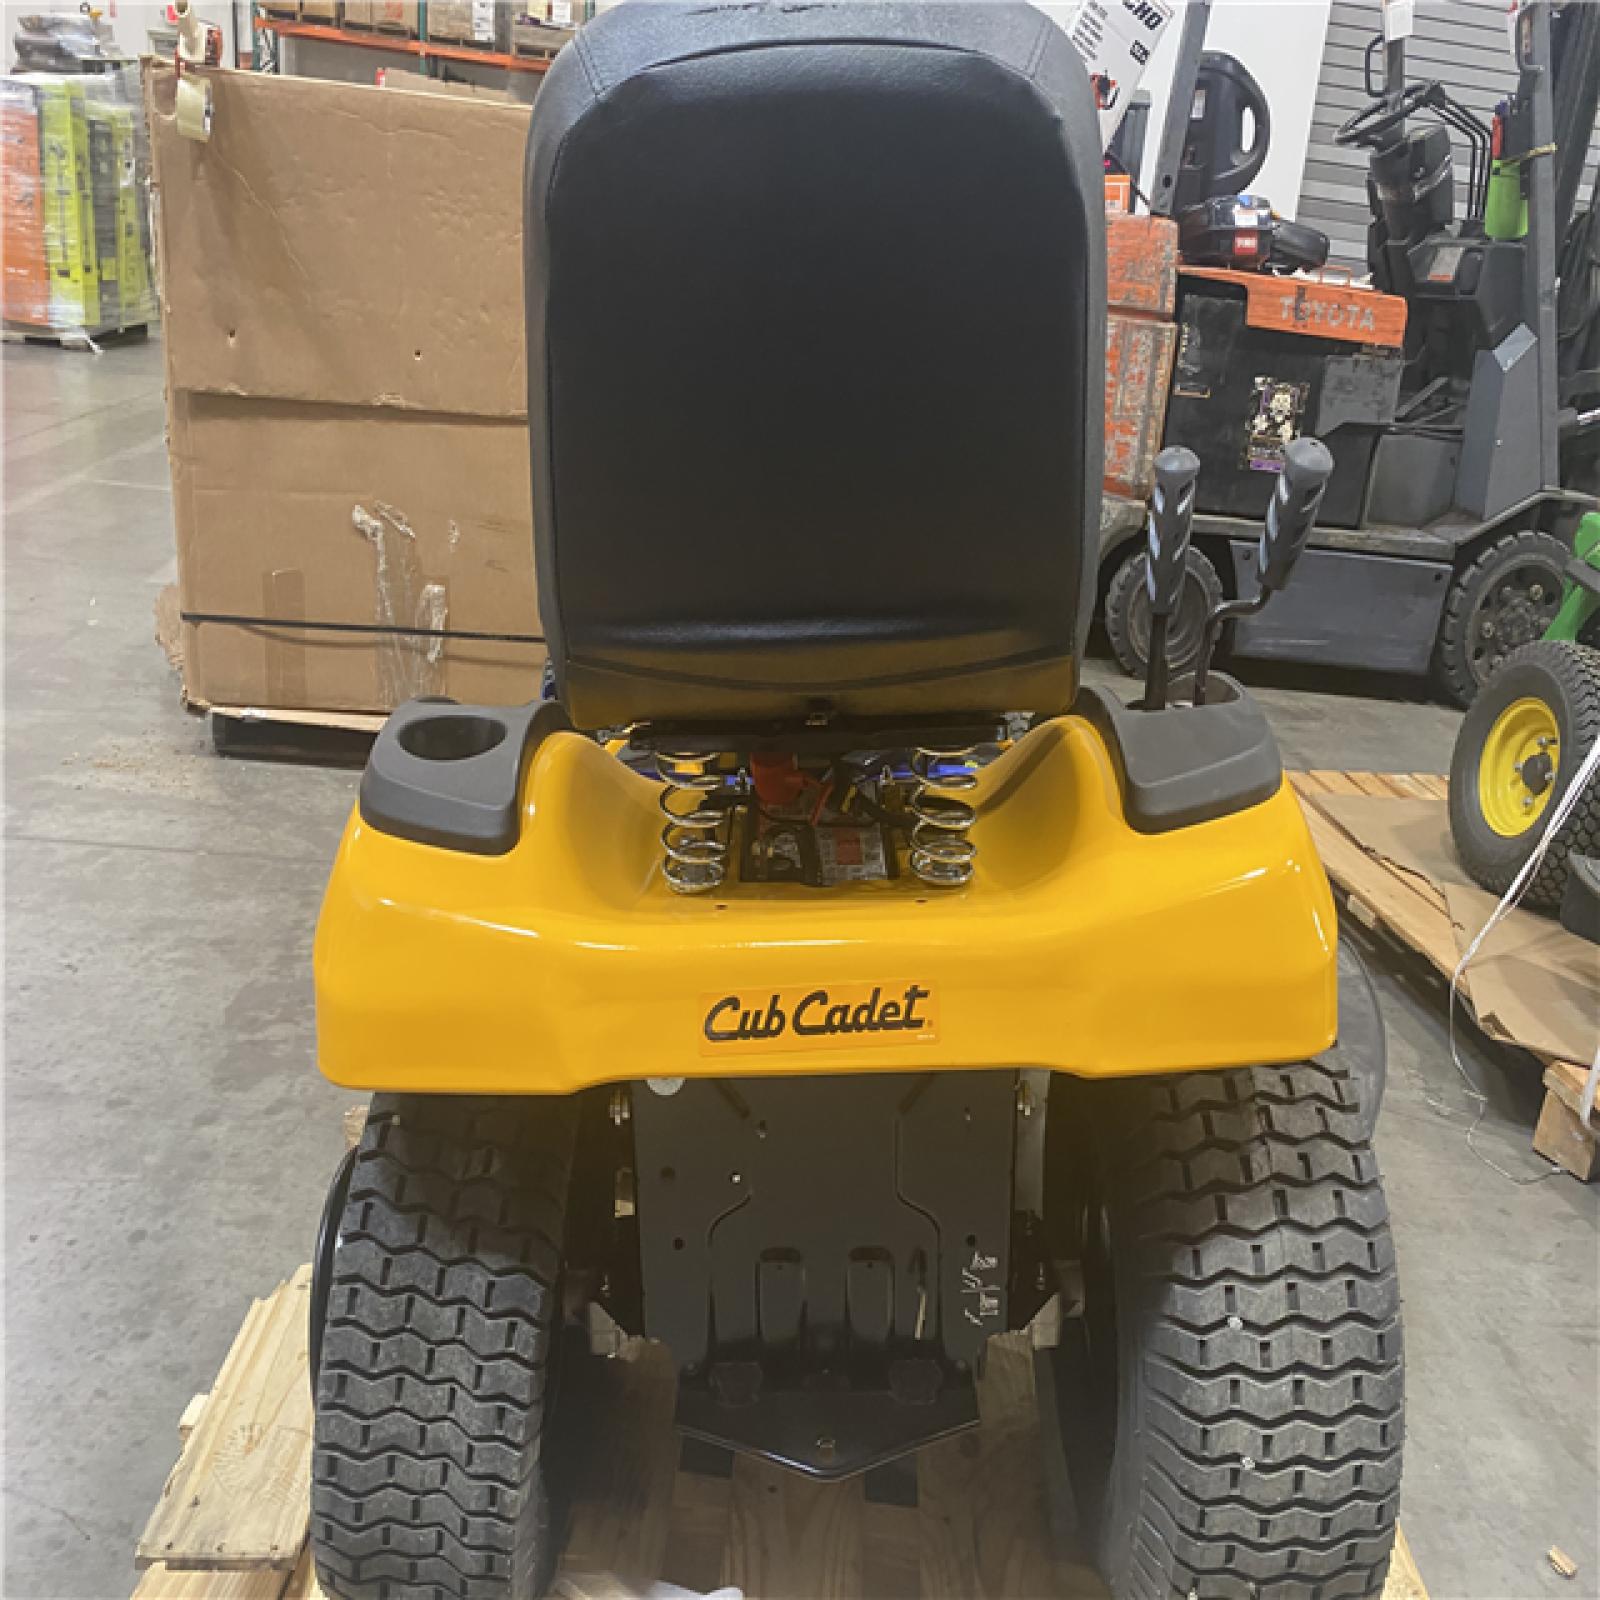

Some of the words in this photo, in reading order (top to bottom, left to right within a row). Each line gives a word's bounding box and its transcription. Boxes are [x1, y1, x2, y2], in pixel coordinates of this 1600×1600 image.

[1279, 296, 1376, 332] TOYOTA
[704, 994, 786, 1041] Cub
[792, 984, 930, 1035] Cadet
